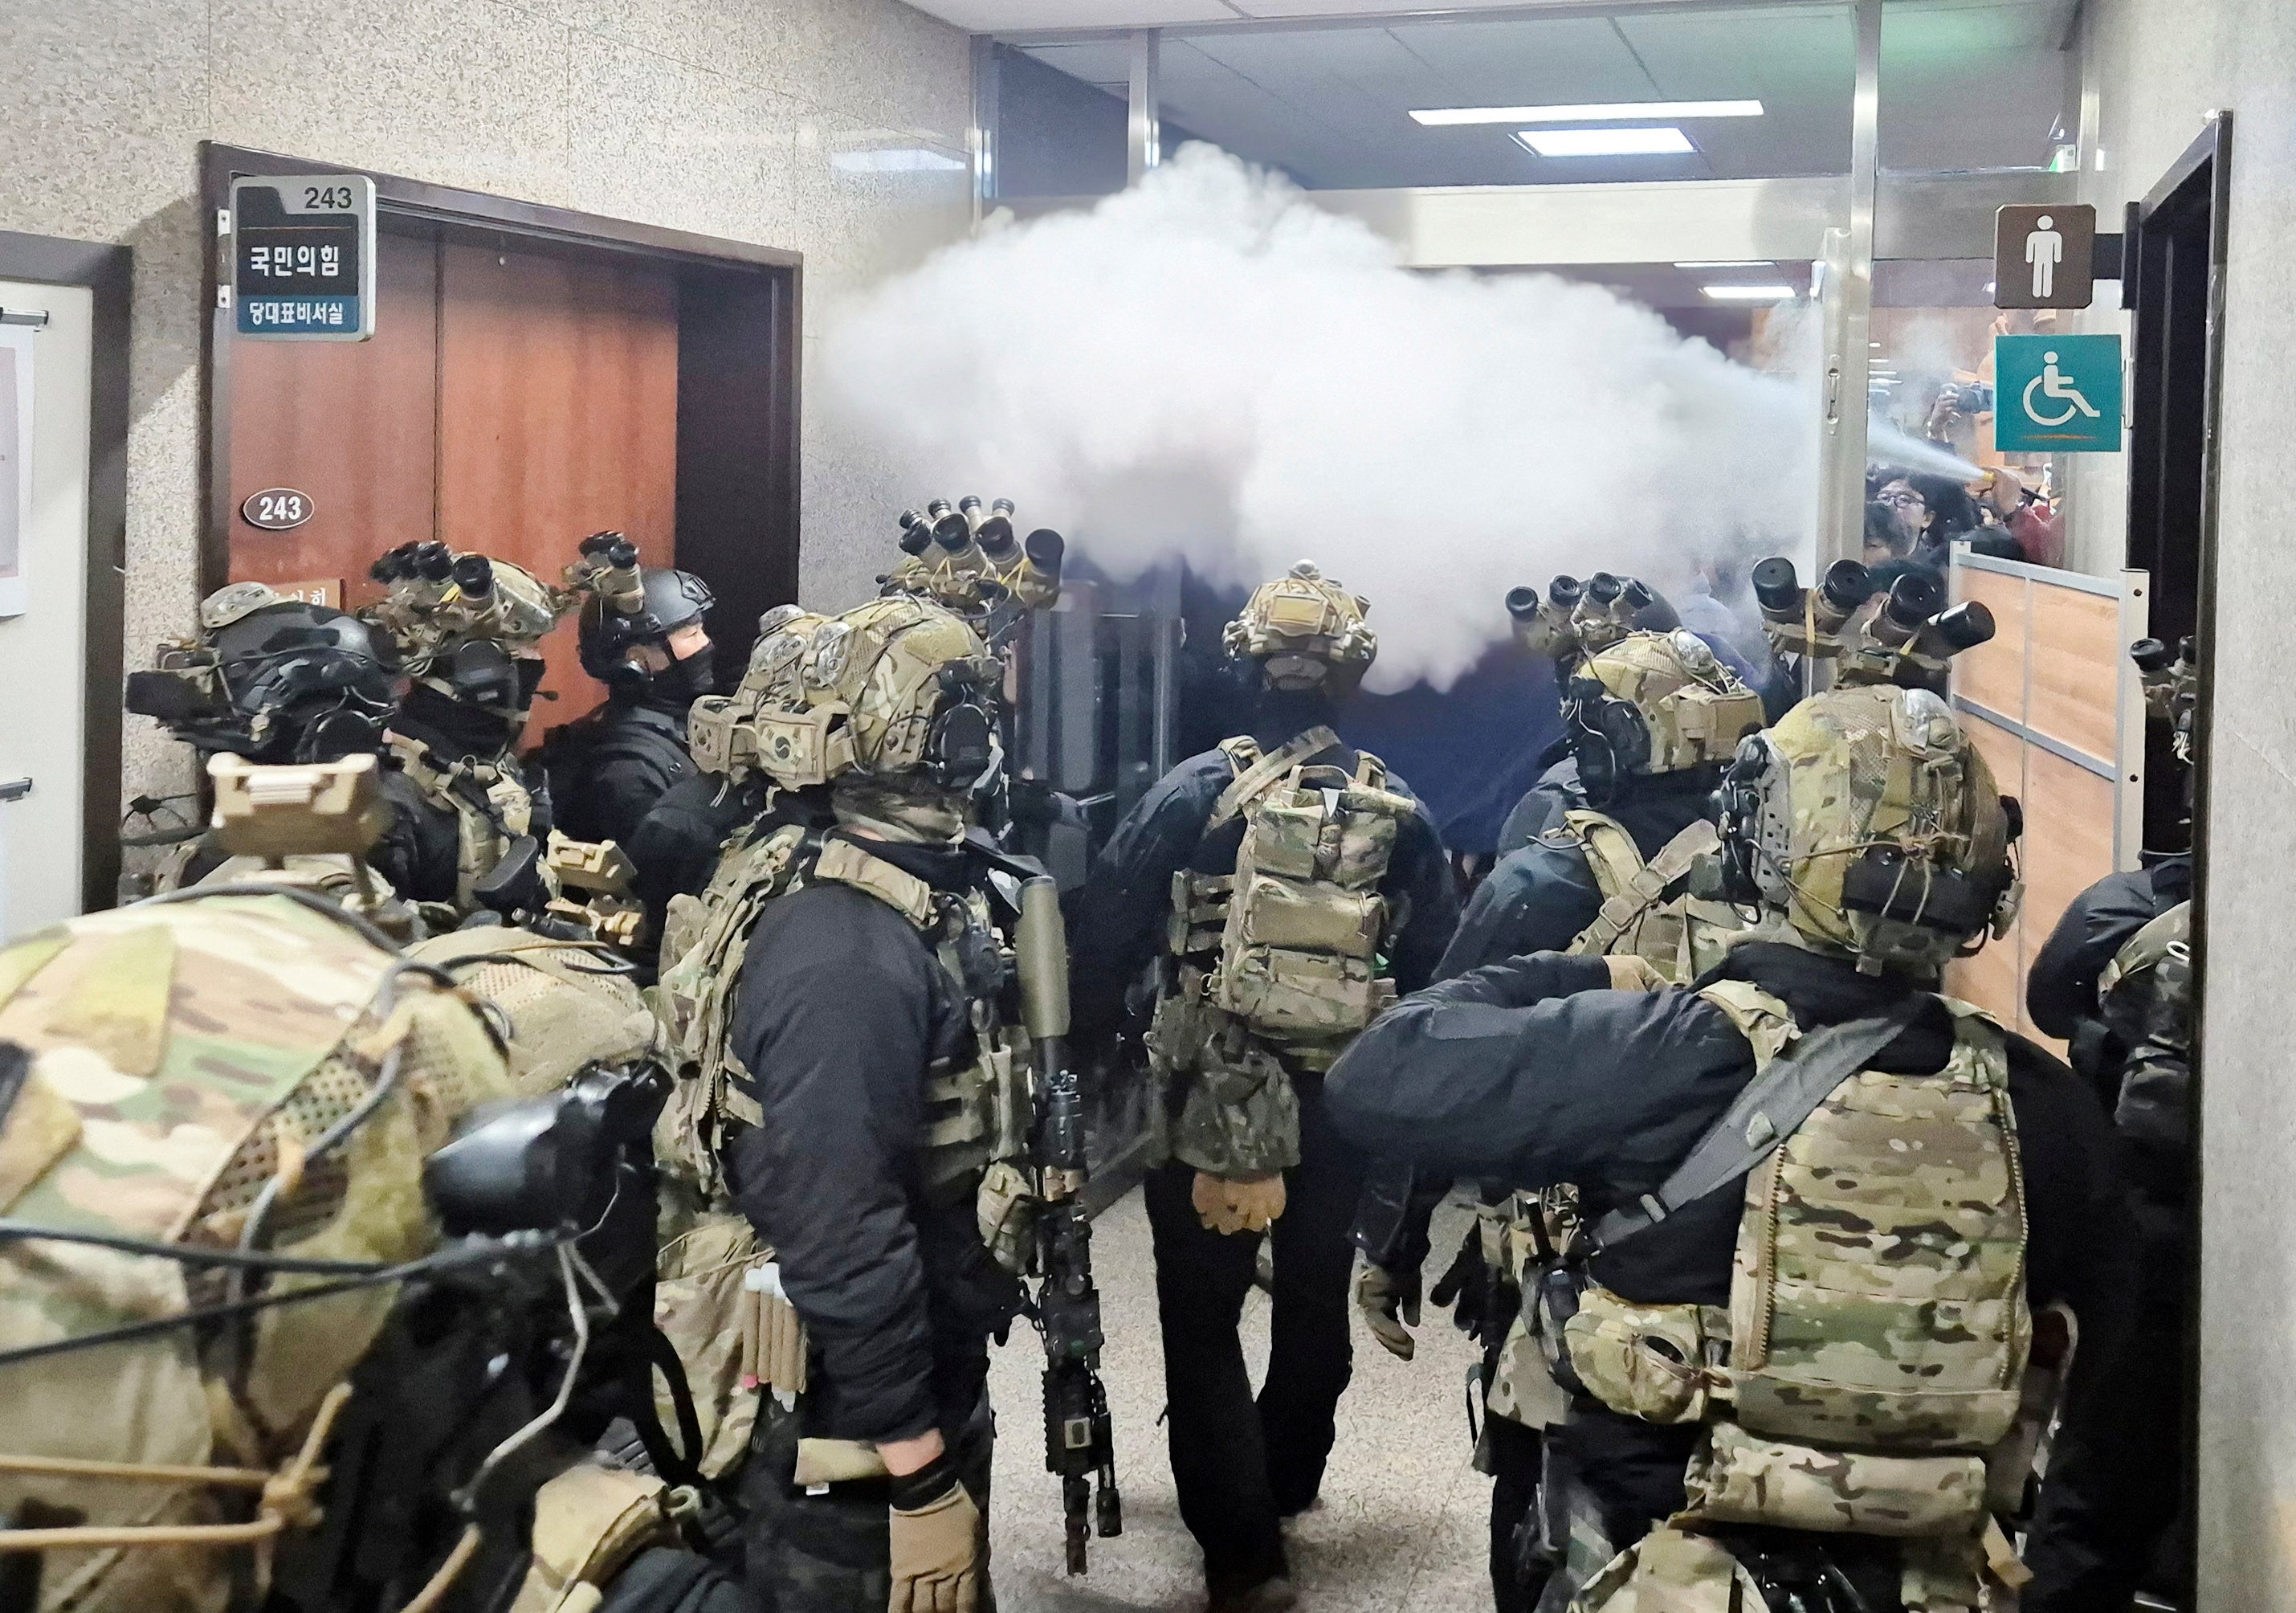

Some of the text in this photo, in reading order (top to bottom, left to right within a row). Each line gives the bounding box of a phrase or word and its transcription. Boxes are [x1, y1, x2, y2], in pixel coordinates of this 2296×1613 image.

[304, 186, 352, 209] 243
[251, 245, 339, 276] 국민의힘
[249, 302, 344, 325] 당대표비서실
[259, 496, 301, 521] 243
